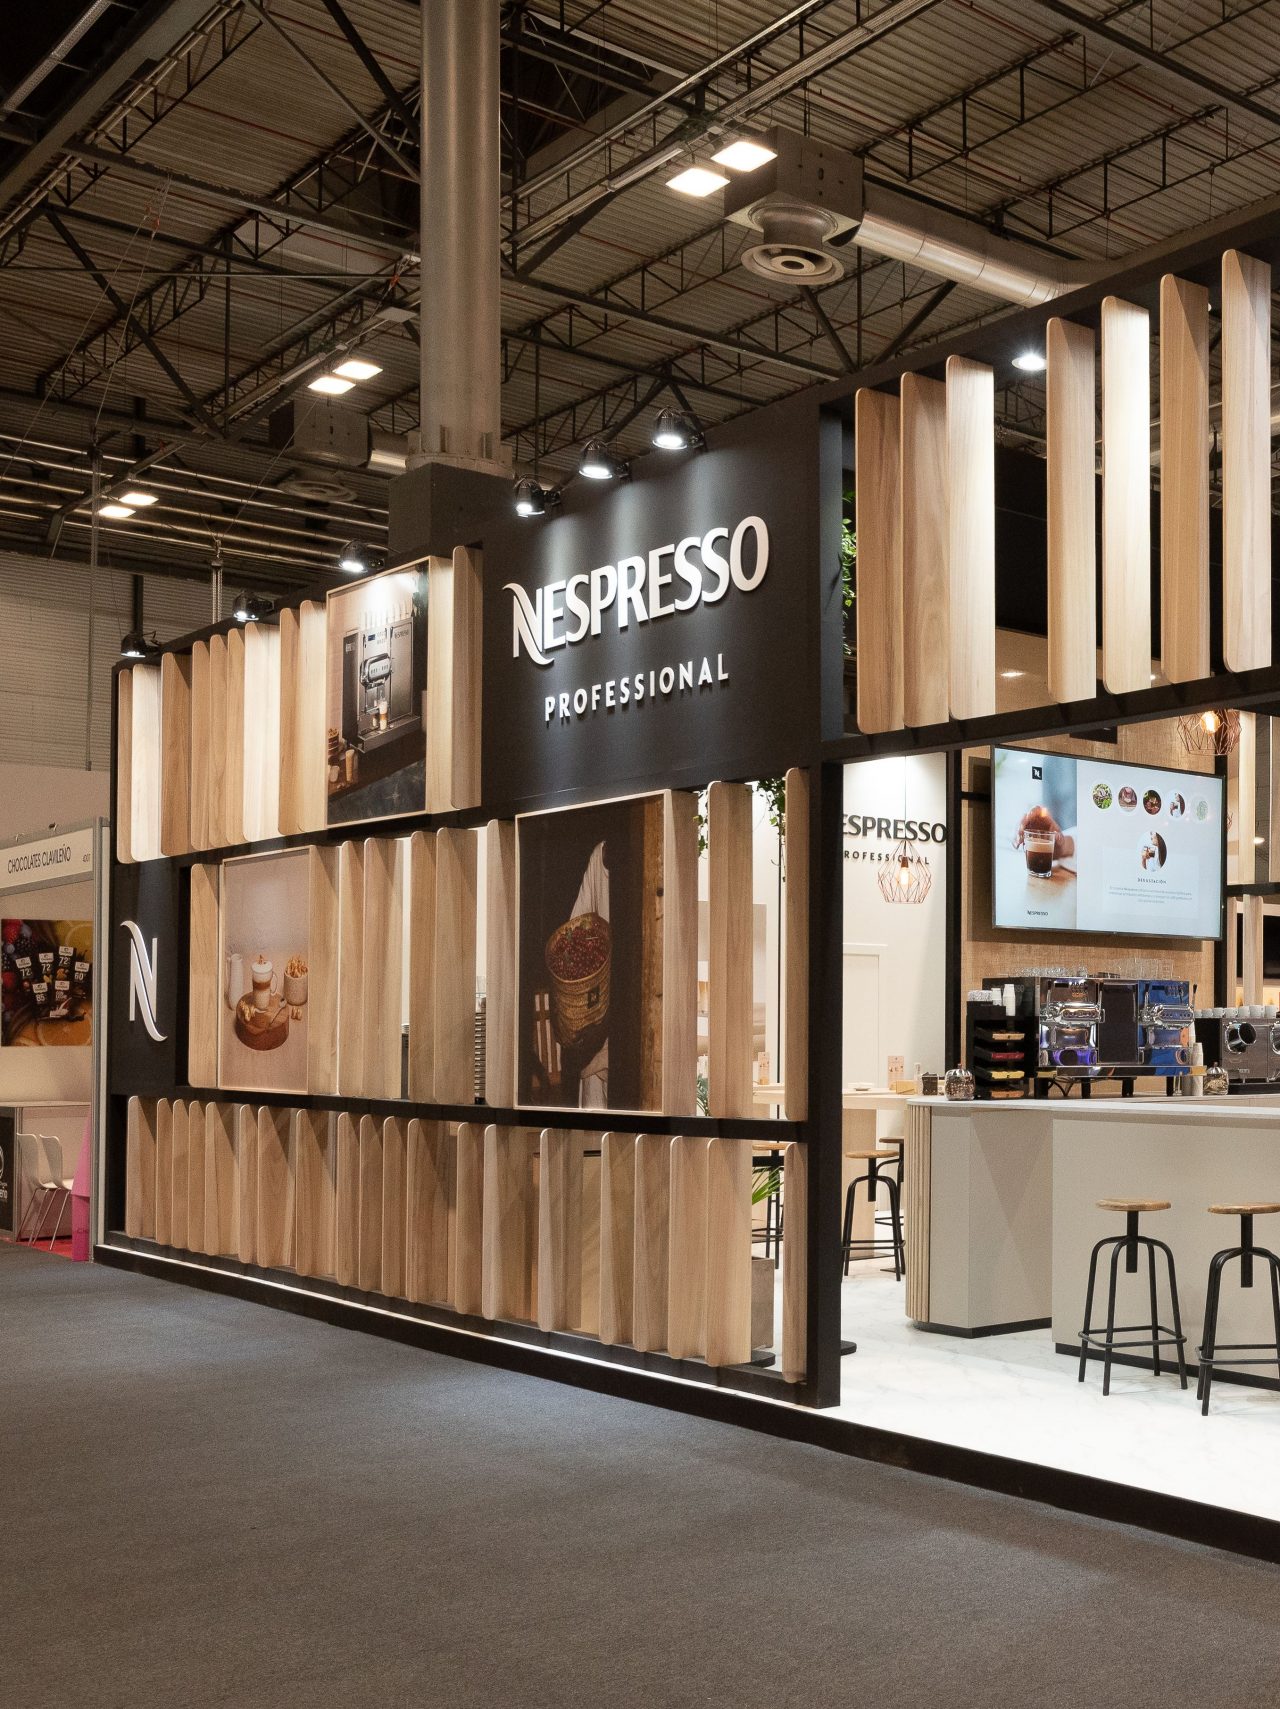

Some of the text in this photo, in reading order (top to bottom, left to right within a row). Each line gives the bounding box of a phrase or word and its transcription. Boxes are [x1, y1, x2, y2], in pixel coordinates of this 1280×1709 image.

[502, 515, 771, 665] NESPRESSO
[545, 653, 730, 722] PROFESSIONAL
[843, 814, 948, 844] ESPRESSO
[8, 853, 41, 874] CHOCOLATES
[844, 850, 929, 865] ROFESSIONAL
